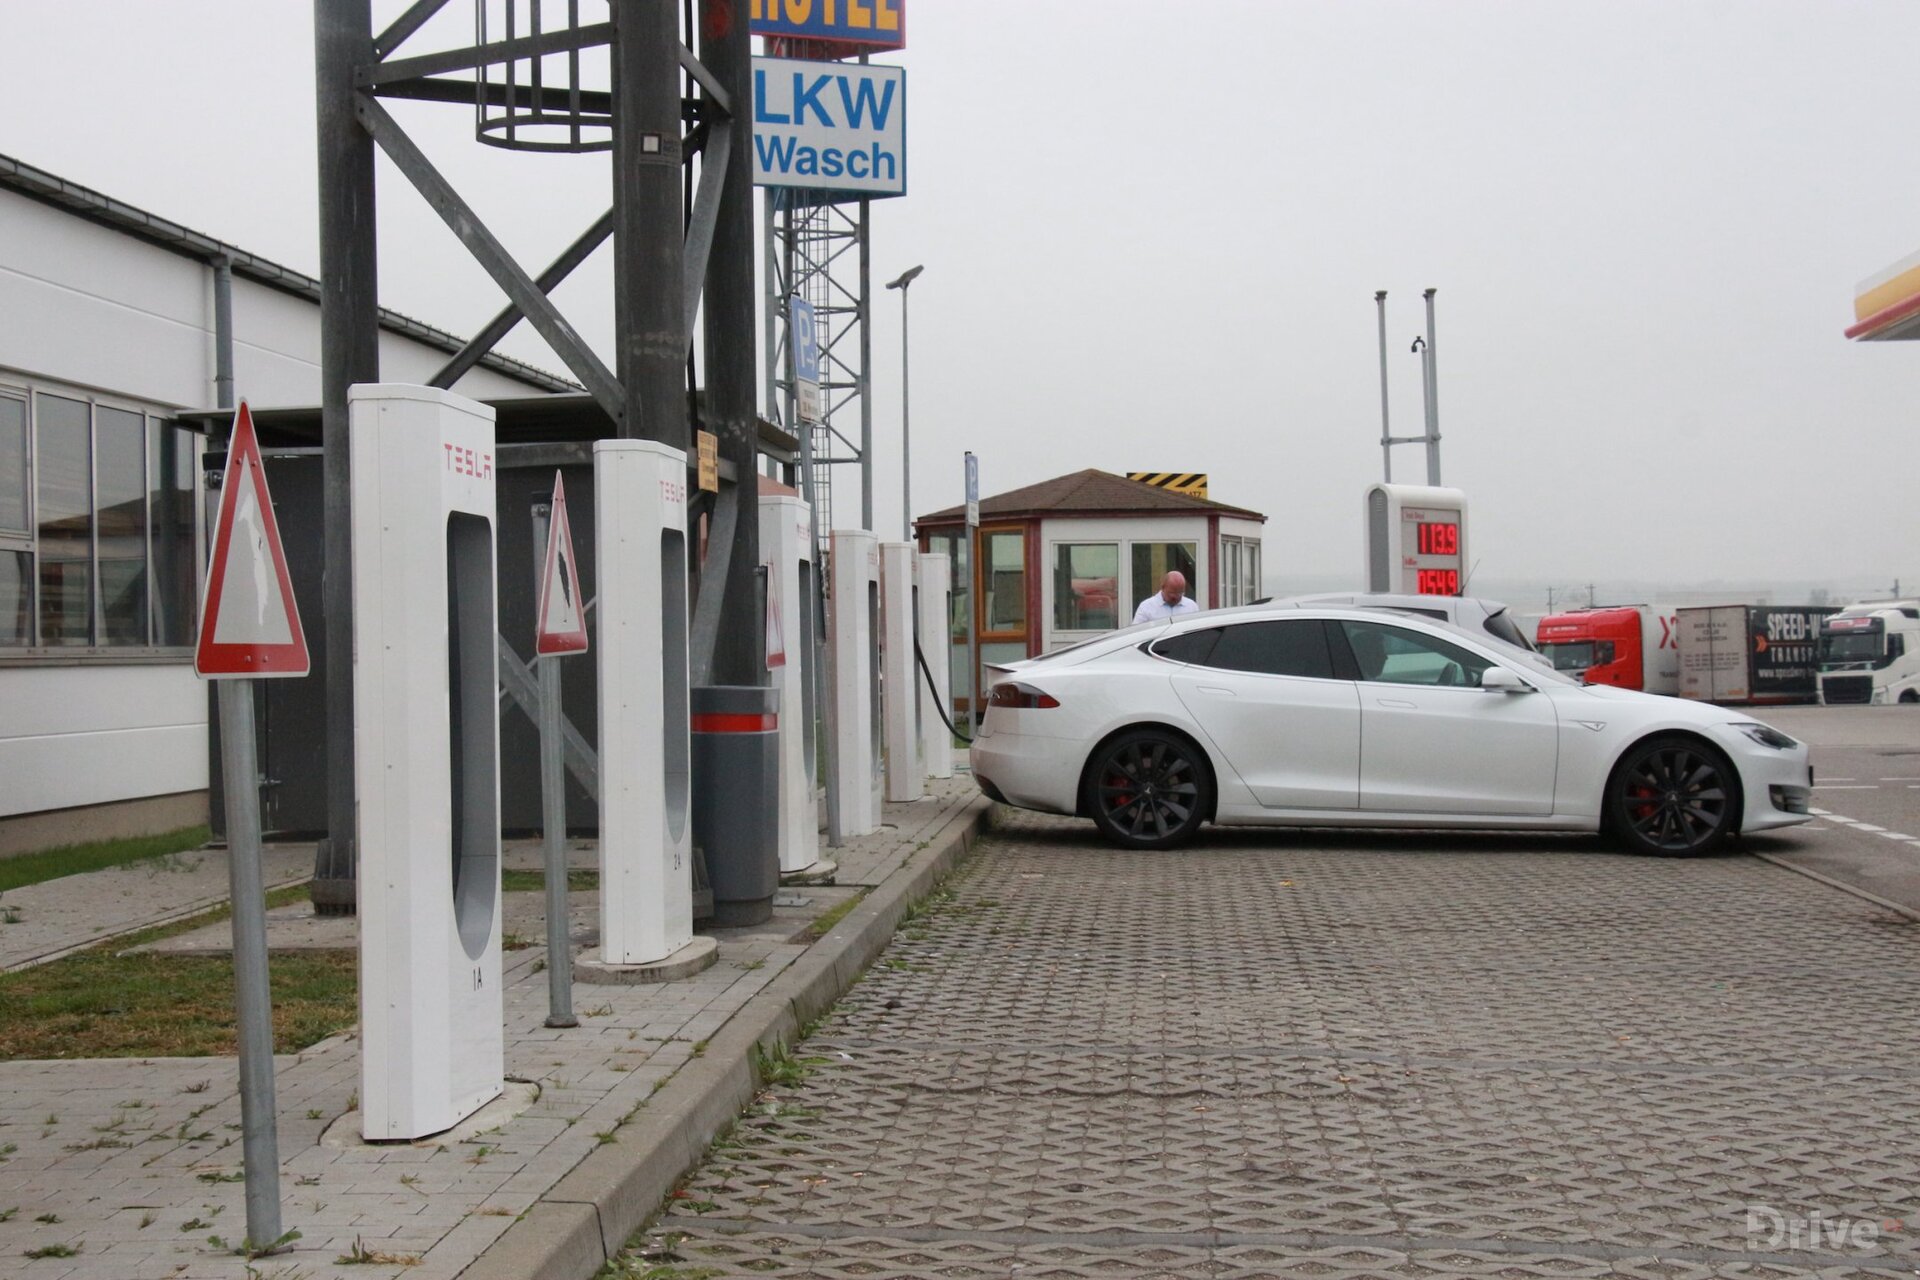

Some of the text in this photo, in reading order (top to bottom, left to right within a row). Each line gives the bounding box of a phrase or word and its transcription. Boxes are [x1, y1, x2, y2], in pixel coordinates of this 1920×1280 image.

[755, 69, 897, 131] LKW
[754, 134, 896, 181] Wasch
[444, 443, 492, 481] TESLA
[1767, 613, 1827, 641] SPEED-W
